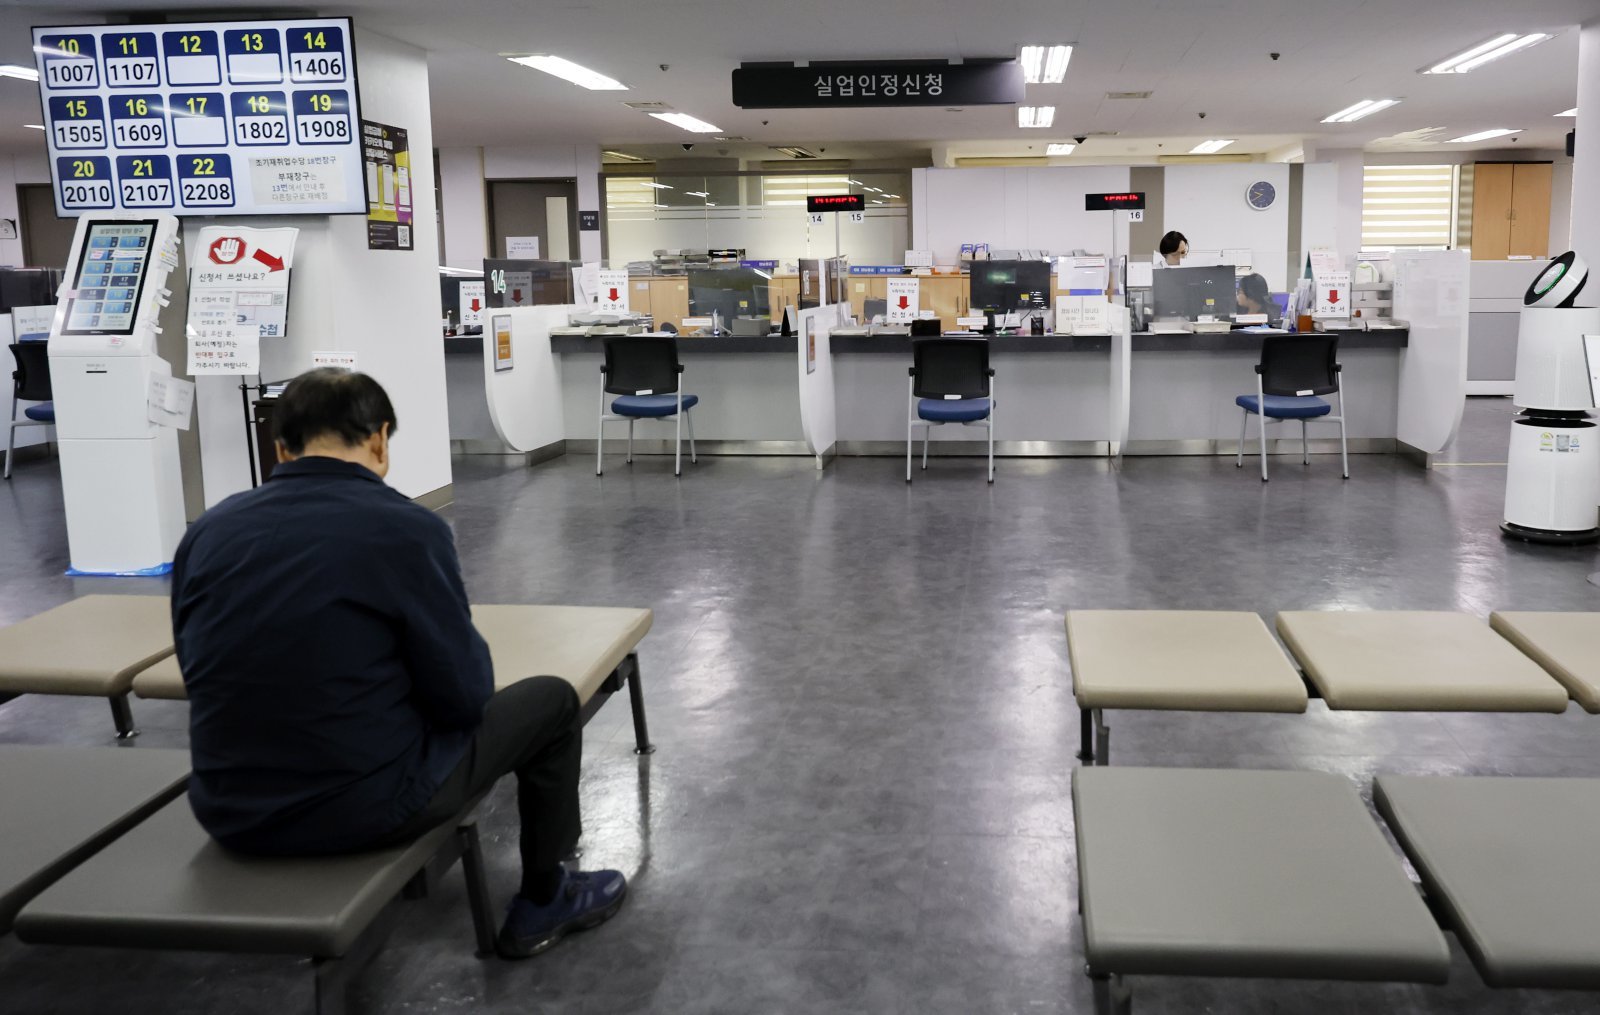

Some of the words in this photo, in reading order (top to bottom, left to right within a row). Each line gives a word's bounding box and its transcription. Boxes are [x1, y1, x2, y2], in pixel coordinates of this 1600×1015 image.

[57, 39, 79, 55] 10
[119, 37, 138, 54] 11
[180, 35, 202, 53] 12
[241, 34, 264, 51] 13
[304, 32, 326, 50] 14
[50, 65, 94, 83] 1007
[110, 63, 155, 81] 1107
[294, 58, 342, 77] 1406
[814, 73, 944, 97] 실업인정신청
[66, 100, 88, 118] 15
[126, 99, 148, 116] 16
[186, 97, 207, 115] 17
[248, 95, 270, 113] 18
[309, 94, 332, 112] 19
[58, 125, 103, 143] 1505
[117, 124, 162, 142] 1609
[239, 122, 285, 140] 1802
[300, 120, 347, 138] 1908
[73, 160, 95, 178] 20
[132, 159, 153, 176] 21
[193, 157, 215, 176] 22
[256, 158, 305, 167] 조기재취업수당
[278, 172, 317, 181] 부재창구는
[65, 185, 110, 203] 2010
[125, 184, 169, 202] 2107
[184, 183, 231, 201] 2208
[851, 213, 861, 221] 15
[1130, 211, 1141, 219] 16
[199, 273, 222, 283] 신청서
[227, 272, 266, 282] 쓰셨나요?
[491, 269, 506, 293] 14
